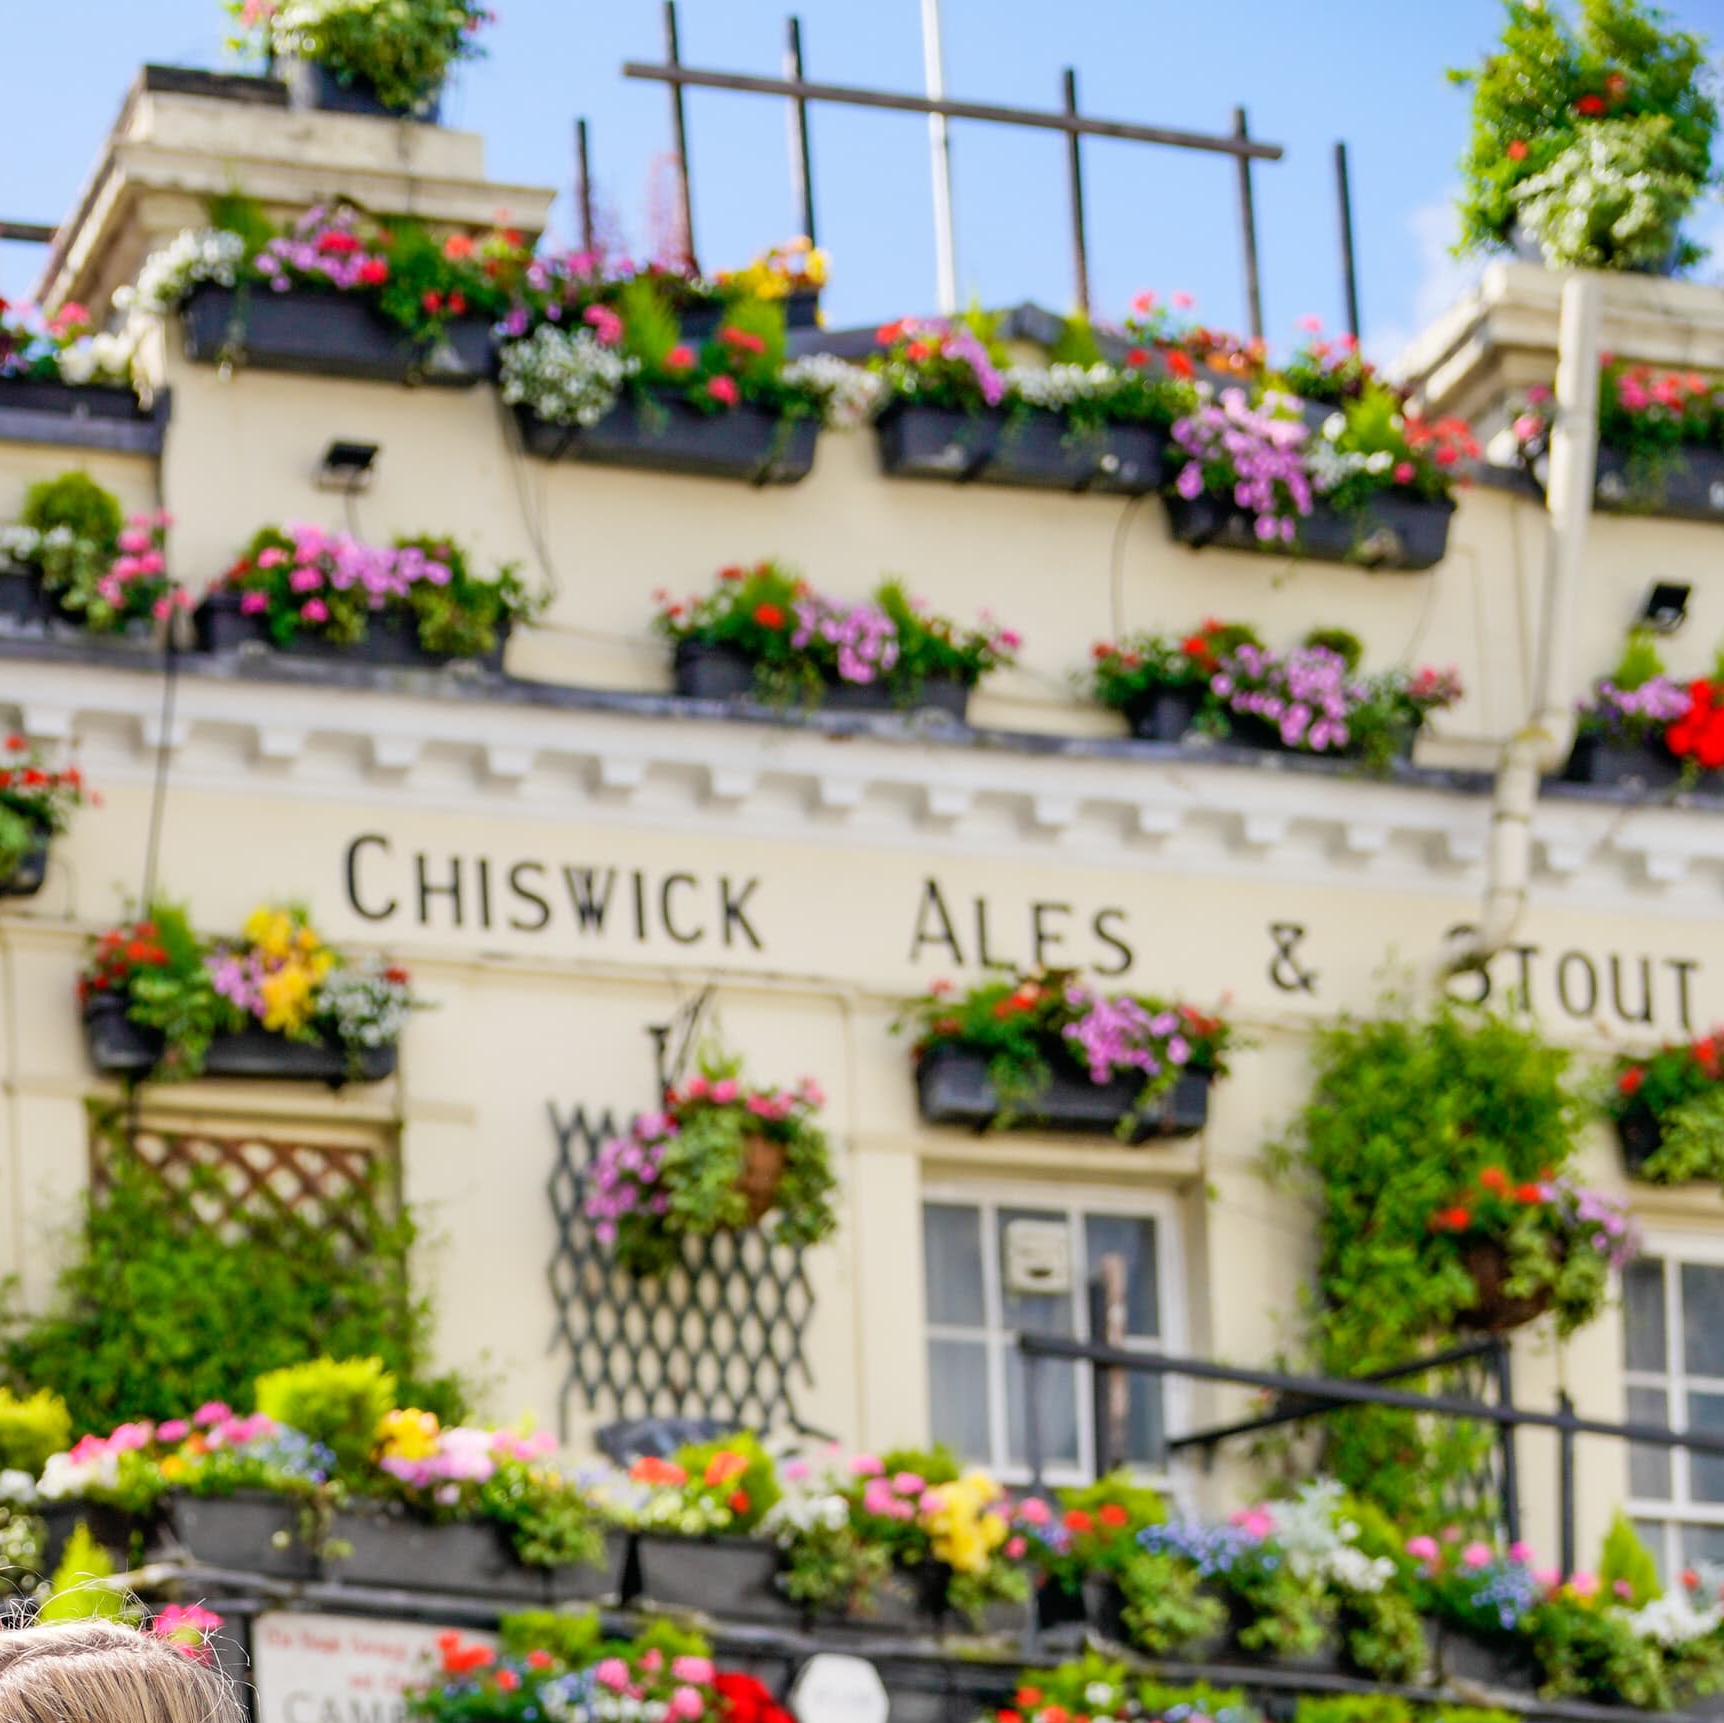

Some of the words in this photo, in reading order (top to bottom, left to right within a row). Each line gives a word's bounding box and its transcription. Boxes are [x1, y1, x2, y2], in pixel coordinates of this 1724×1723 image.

[345, 833, 765, 952] CHISWICK
[909, 876, 1135, 977] ALES
[1267, 920, 1319, 995] &
